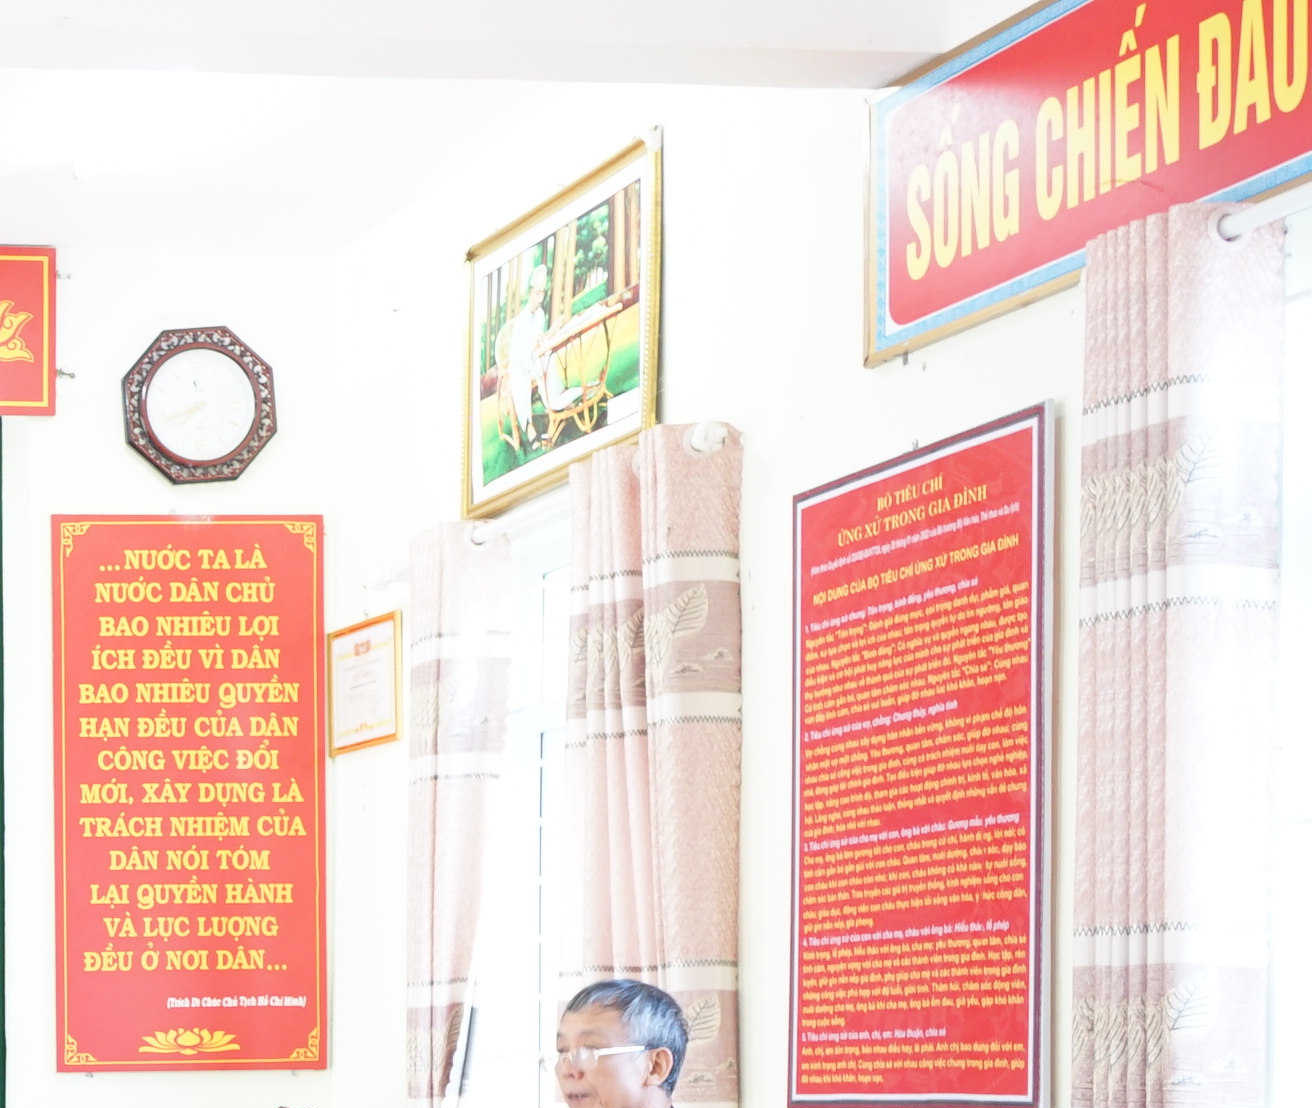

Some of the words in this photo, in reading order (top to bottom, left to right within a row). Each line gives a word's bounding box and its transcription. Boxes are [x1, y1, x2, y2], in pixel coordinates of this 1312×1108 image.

[906, 104, 1019, 280] SỐNG
[1036, 4, 1179, 221] CHIẾN
[198, 550, 231, 569] TA
[235, 544, 267, 569] LÀ
[170, 577, 219, 602] DÂN
[226, 576, 275, 602] CHỦ
[99, 616, 148, 636] BAO
[156, 611, 231, 637] NHIÊU
[239, 616, 279, 641] LỢI
[92, 645, 135, 669] ÍCH
[143, 640, 192, 669] ĐỀU
[198, 644, 224, 669] VÌ
[231, 645, 280, 669] DÂN
[79, 683, 128, 703] BAO
[136, 678, 210, 703] NHIÊU
[219, 674, 299, 708] QUYỀN
[79, 718, 130, 741] HẠN
[137, 709, 186, 737] ĐỀU
[194, 710, 244, 737] CỦA
[250, 713, 298, 737] DÂN
[98, 746, 165, 770] CÔNG
[172, 746, 229, 773] VIỆC
[236, 740, 279, 769] ĐỔI
[142, 778, 191, 803] XÂY
[272, 778, 304, 802] LÀ
[79, 812, 163, 837] TRÁCH
[170, 812, 249, 841] NHIỆM
[257, 809, 306, 836] CỦA
[110, 846, 159, 870] DÂN
[166, 845, 209, 870] NÓI
[216, 845, 270, 870] TÓM
[90, 885, 129, 908] LẠI
[137, 876, 218, 909] QUYỀN
[225, 878, 293, 903] HÀNH
[103, 912, 137, 937] VÀ
[84, 943, 133, 971] ĐỀU
[141, 942, 159, 970] Ở
